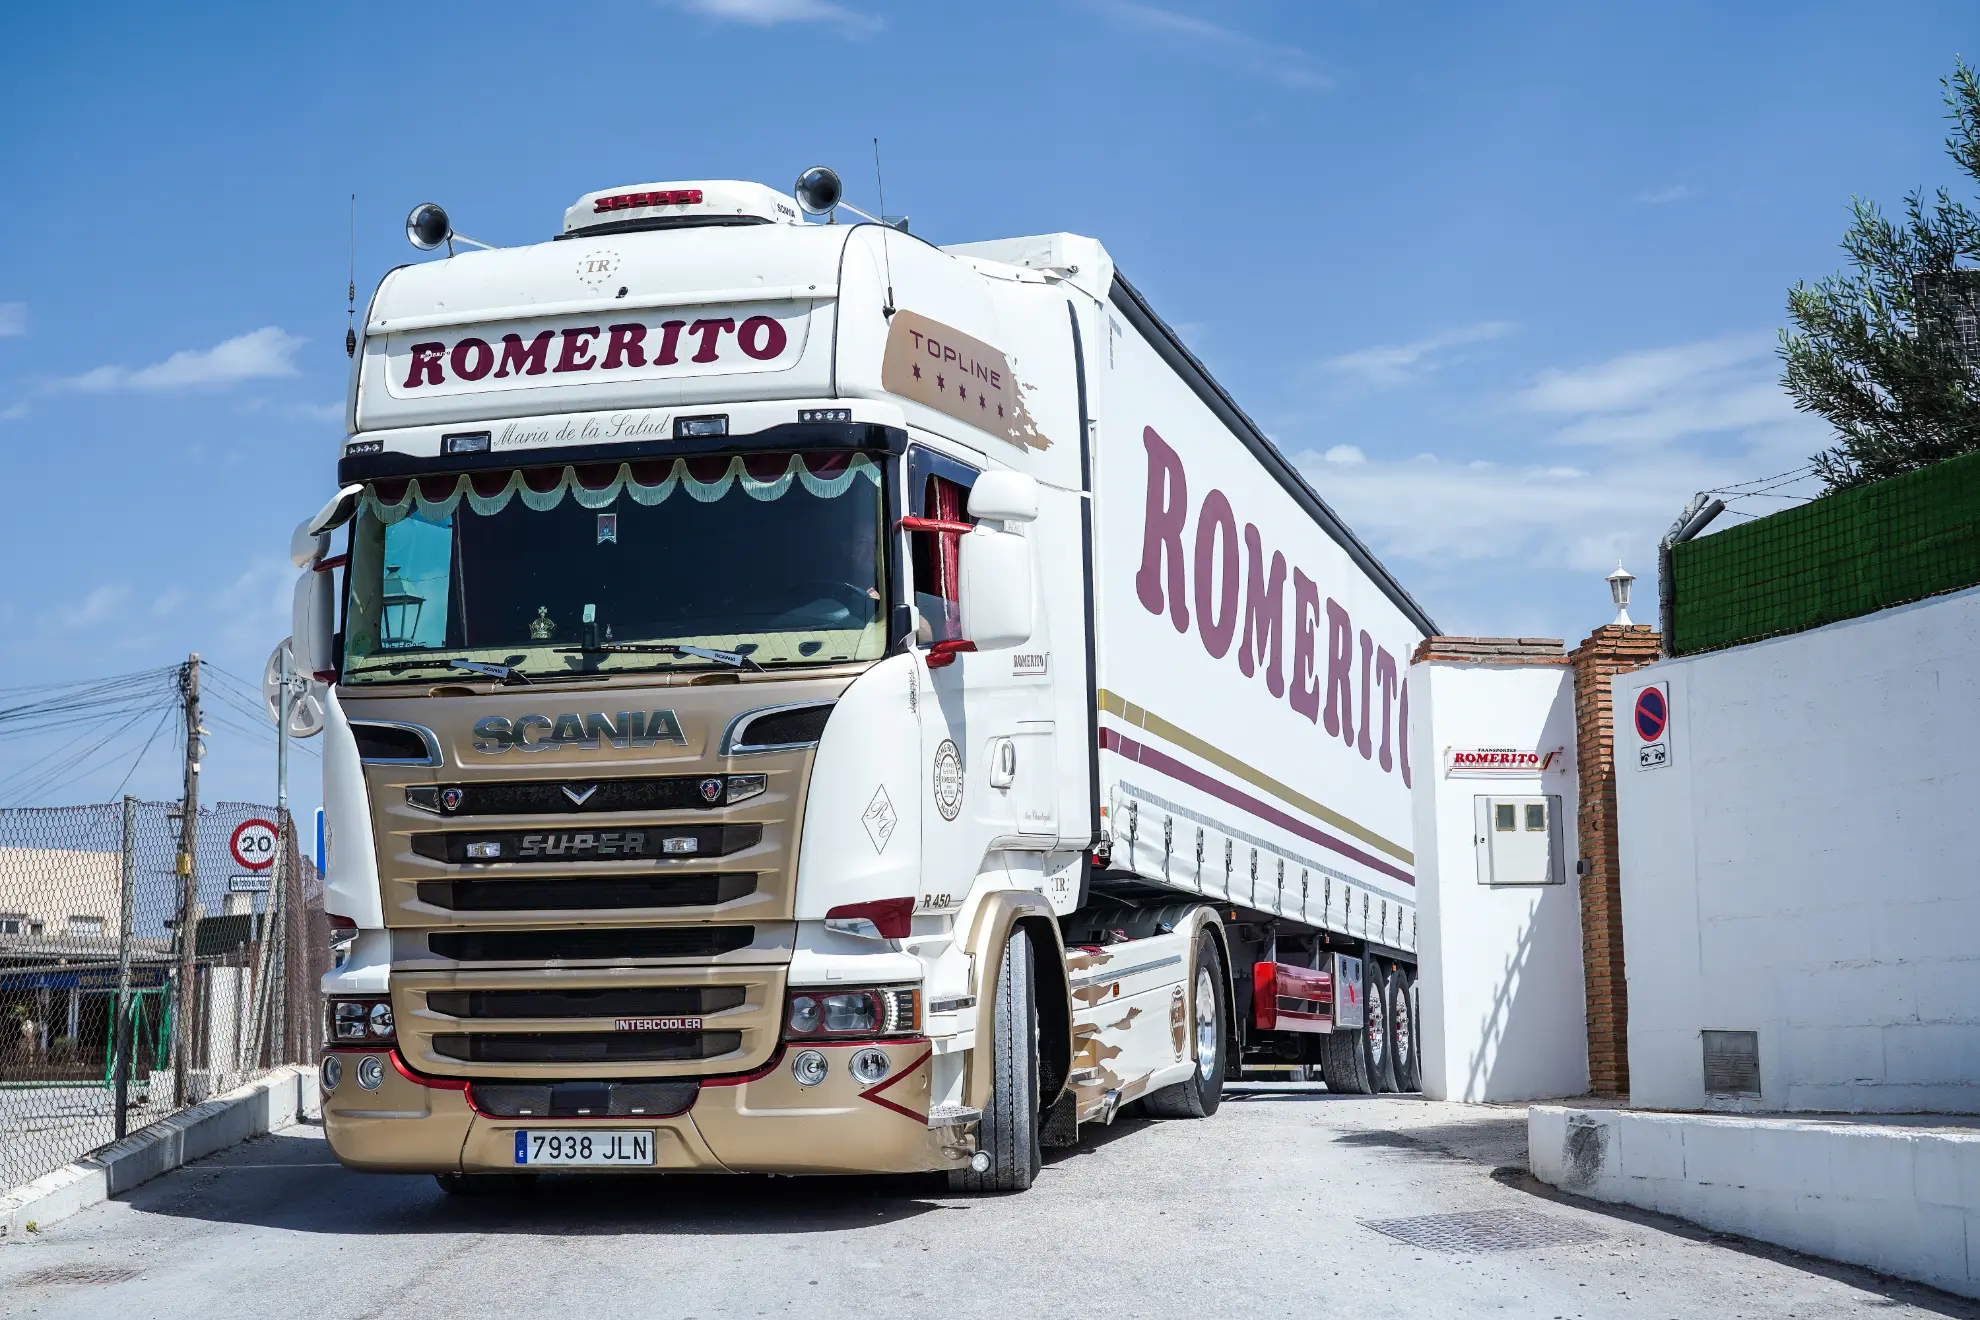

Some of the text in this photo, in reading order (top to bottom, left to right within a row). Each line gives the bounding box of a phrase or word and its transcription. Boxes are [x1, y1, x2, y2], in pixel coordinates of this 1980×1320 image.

[586, 260, 610, 273] TR
[403, 315, 787, 388] ROMERITO
[910, 329, 1001, 390] TOPLINE
[494, 423, 549, 446] Maria
[555, 420, 576, 441] de
[606, 414, 671, 437] Salud
[714, 652, 736, 662] SCANIA
[1013, 654, 1044, 668] ROMERITO
[482, 665, 503, 674] SCANIA
[472, 708, 688, 755] SCANIA
[1454, 752, 1539, 764] ROMERITO
[242, 836, 271, 852] 20
[519, 832, 645, 857] SUPER
[1055, 878, 1066, 892] TR
[923, 893, 951, 908] R 450
[615, 1019, 701, 1031] INTERCOOLER
[518, 1150, 524, 1158] E
[533, 1136, 647, 1160] 7938 JLN
